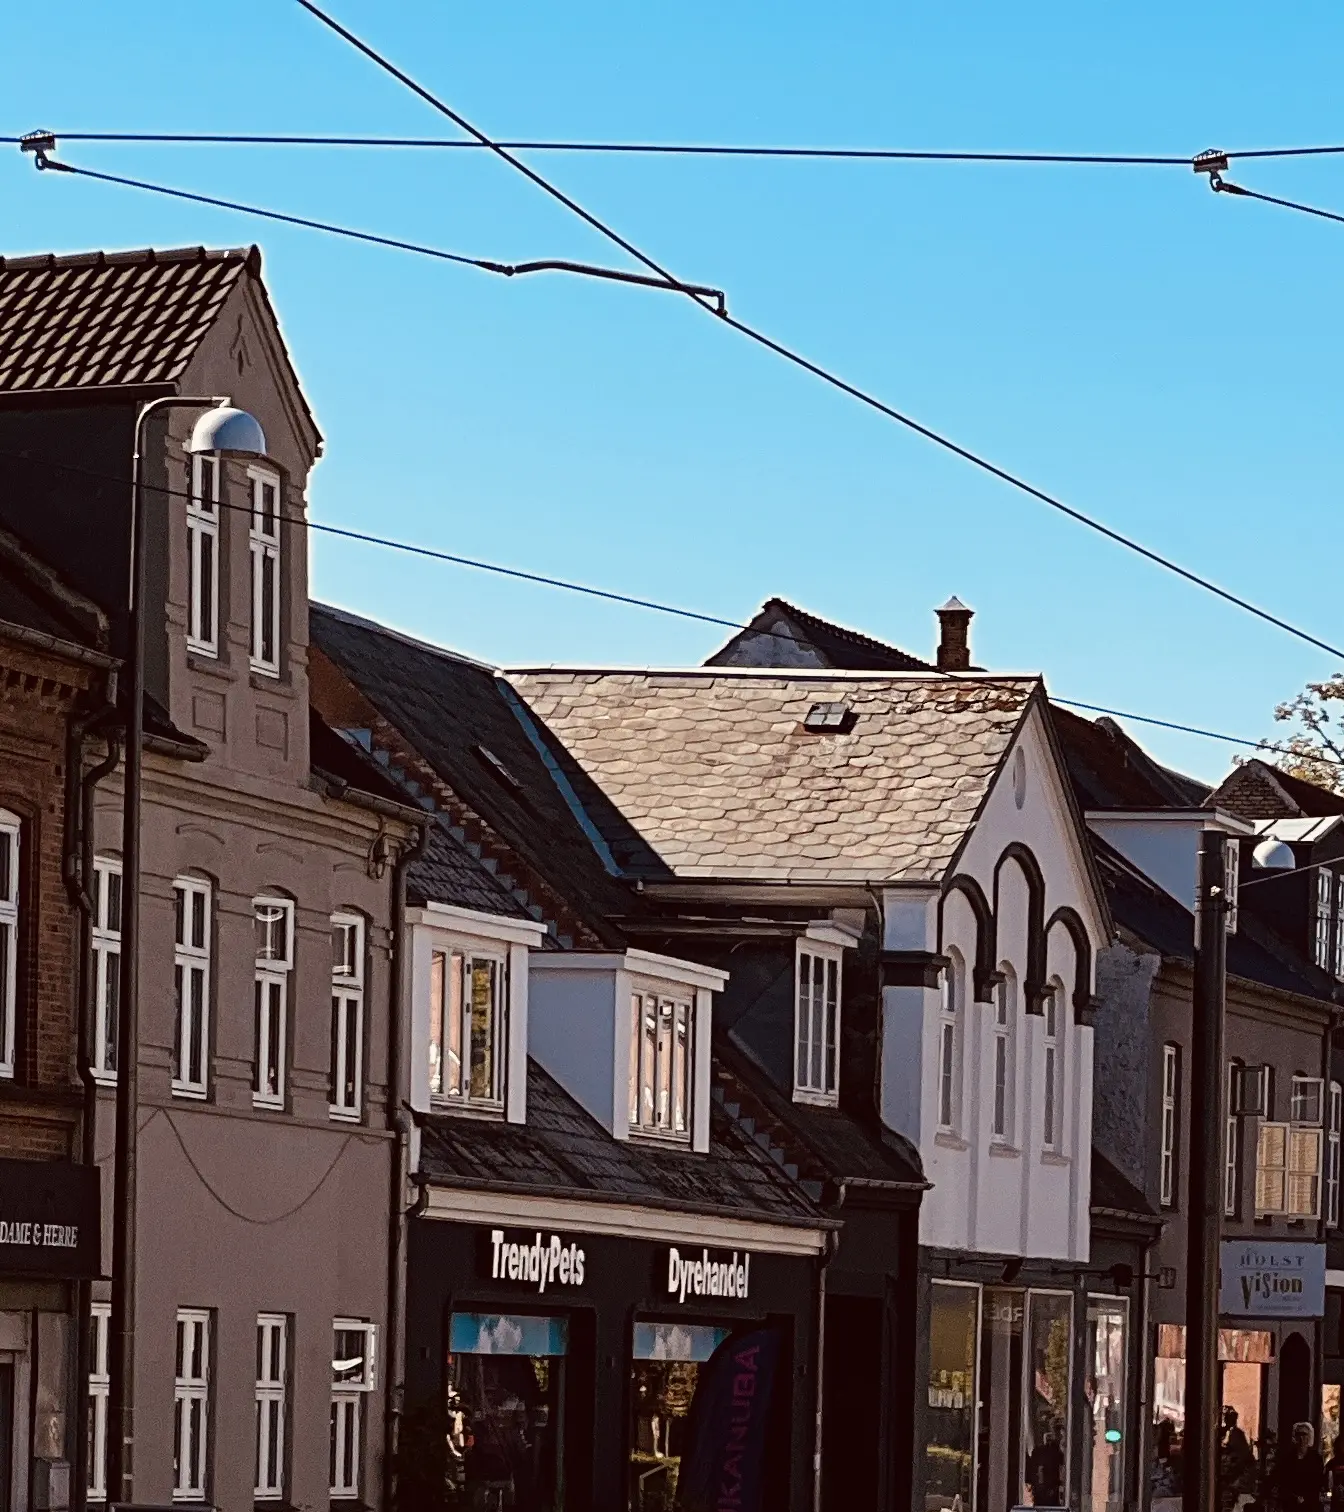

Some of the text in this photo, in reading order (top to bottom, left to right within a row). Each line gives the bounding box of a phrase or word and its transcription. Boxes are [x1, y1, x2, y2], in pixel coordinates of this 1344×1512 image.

[33, 1223, 41, 1246] &
[42, 1223, 79, 1248] HERRE
[491, 1229, 585, 1293] TrendyPets
[668, 1247, 750, 1303] Dyrehandel
[1240, 1253, 1304, 1268] HOLST
